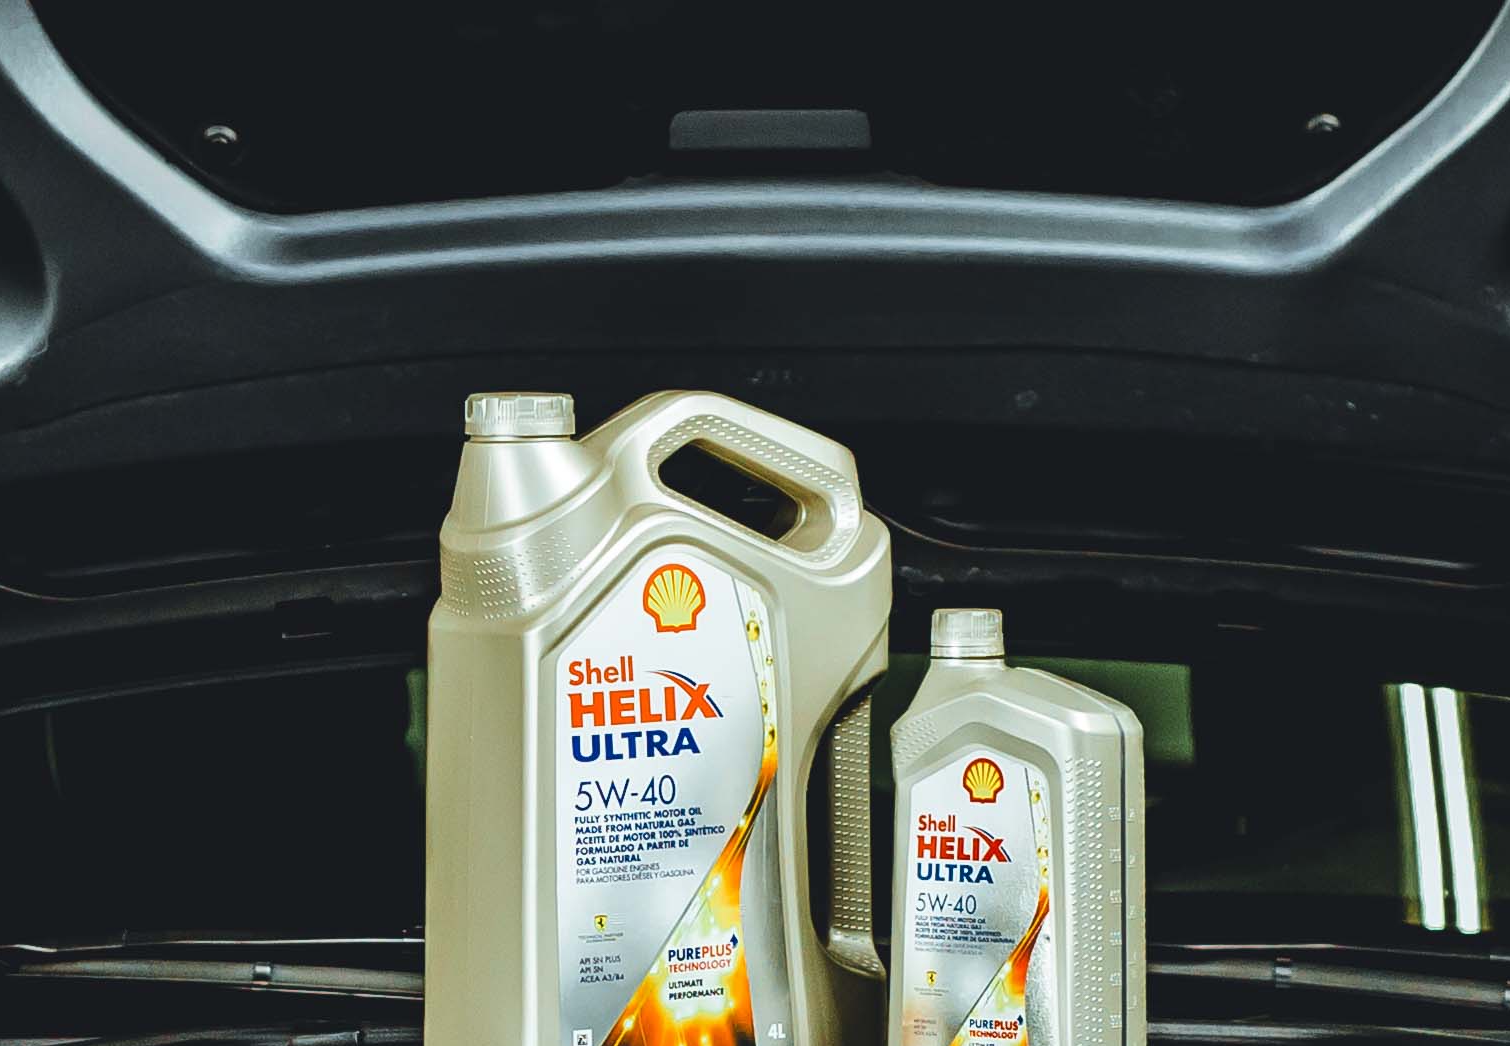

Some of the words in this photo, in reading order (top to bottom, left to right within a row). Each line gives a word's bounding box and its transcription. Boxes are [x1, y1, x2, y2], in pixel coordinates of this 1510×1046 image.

[568, 655, 634, 686] Shell
[567, 682, 719, 729] HELIX
[571, 727, 701, 763] ULTRA
[574, 774, 677, 811] 5W-40
[574, 815, 600, 824] FULLY
[604, 811, 651, 822] SYNTHETIC
[654, 808, 686, 818] MOTOR
[688, 807, 702, 816] OIL
[918, 814, 956, 832] Shell
[576, 825, 602, 835] MADE
[605, 823, 632, 833] FROM
[635, 820, 675, 831] NATURAL
[677, 818, 696, 827] GAS
[576, 835, 605, 845] ACEITE
[609, 834, 620, 843] DE
[623, 831, 656, 842] MOTOR
[659, 830, 682, 839] 100%
[575, 843, 635, 856] FORMULADO
[646, 840, 676, 851] PARTIR
[678, 839, 689, 848] DE
[917, 835, 1008, 862] HELIX
[576, 856, 597, 866] GAS
[599, 854, 642, 864] NATURAL
[576, 867, 590, 876] FOR
[592, 864, 629, 875] GASOLINE
[630, 862, 660, 872] ENGINES
[917, 863, 994, 884] ULTRA
[596, 873, 630, 883] MOTORES
[916, 893, 977, 914] 5W-40
[668, 944, 732, 962] PUREPLUS
[668, 959, 731, 973] TECHNOLOGY
[668, 979, 703, 989] ULTIMATE
[669, 988, 724, 1000] PERFORMANCE
[768, 1024, 786, 1039] 4L
[969, 1018, 1019, 1031] PUREPLUS
[969, 1030, 1018, 1039] TECHNOLOGY
